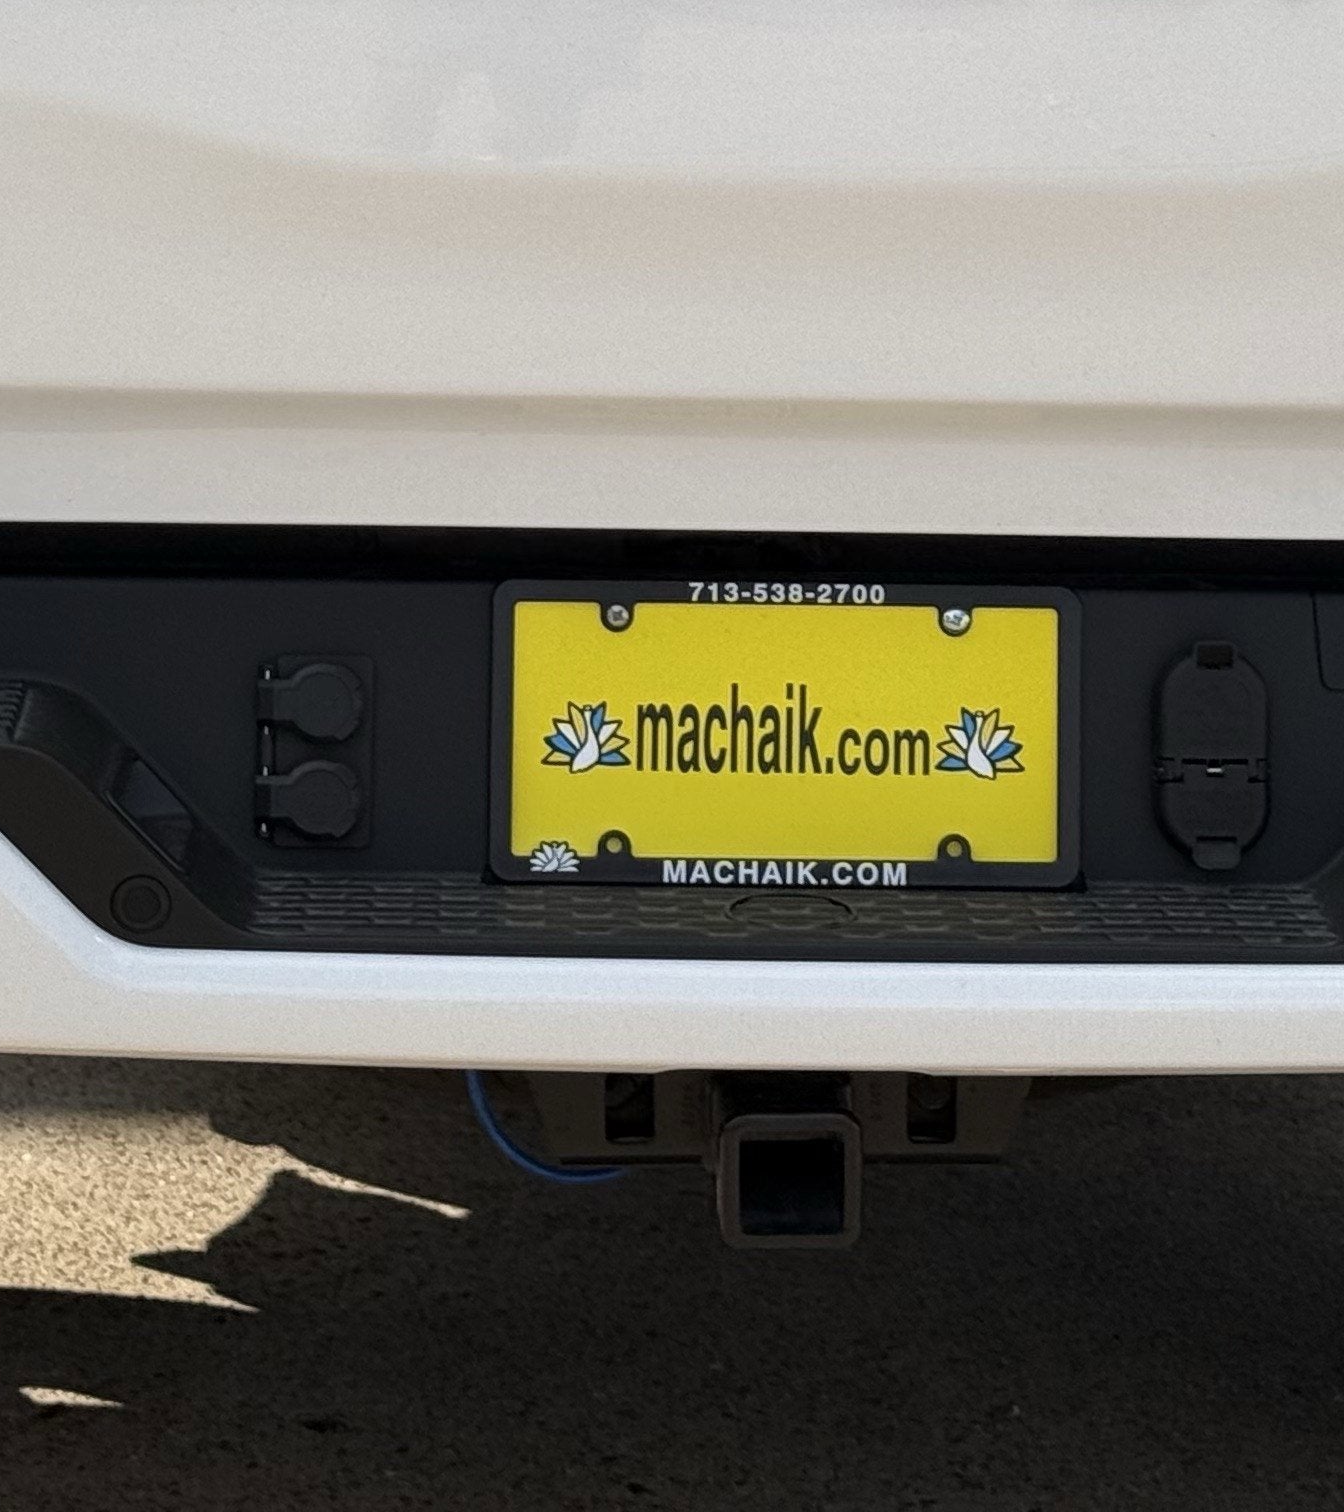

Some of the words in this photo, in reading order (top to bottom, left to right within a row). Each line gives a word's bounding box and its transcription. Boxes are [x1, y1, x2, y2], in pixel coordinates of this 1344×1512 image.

[688, 582, 886, 605] 713-538-2700
[636, 682, 931, 776] machaik.com
[662, 859, 909, 887] MACHAIK.COM
